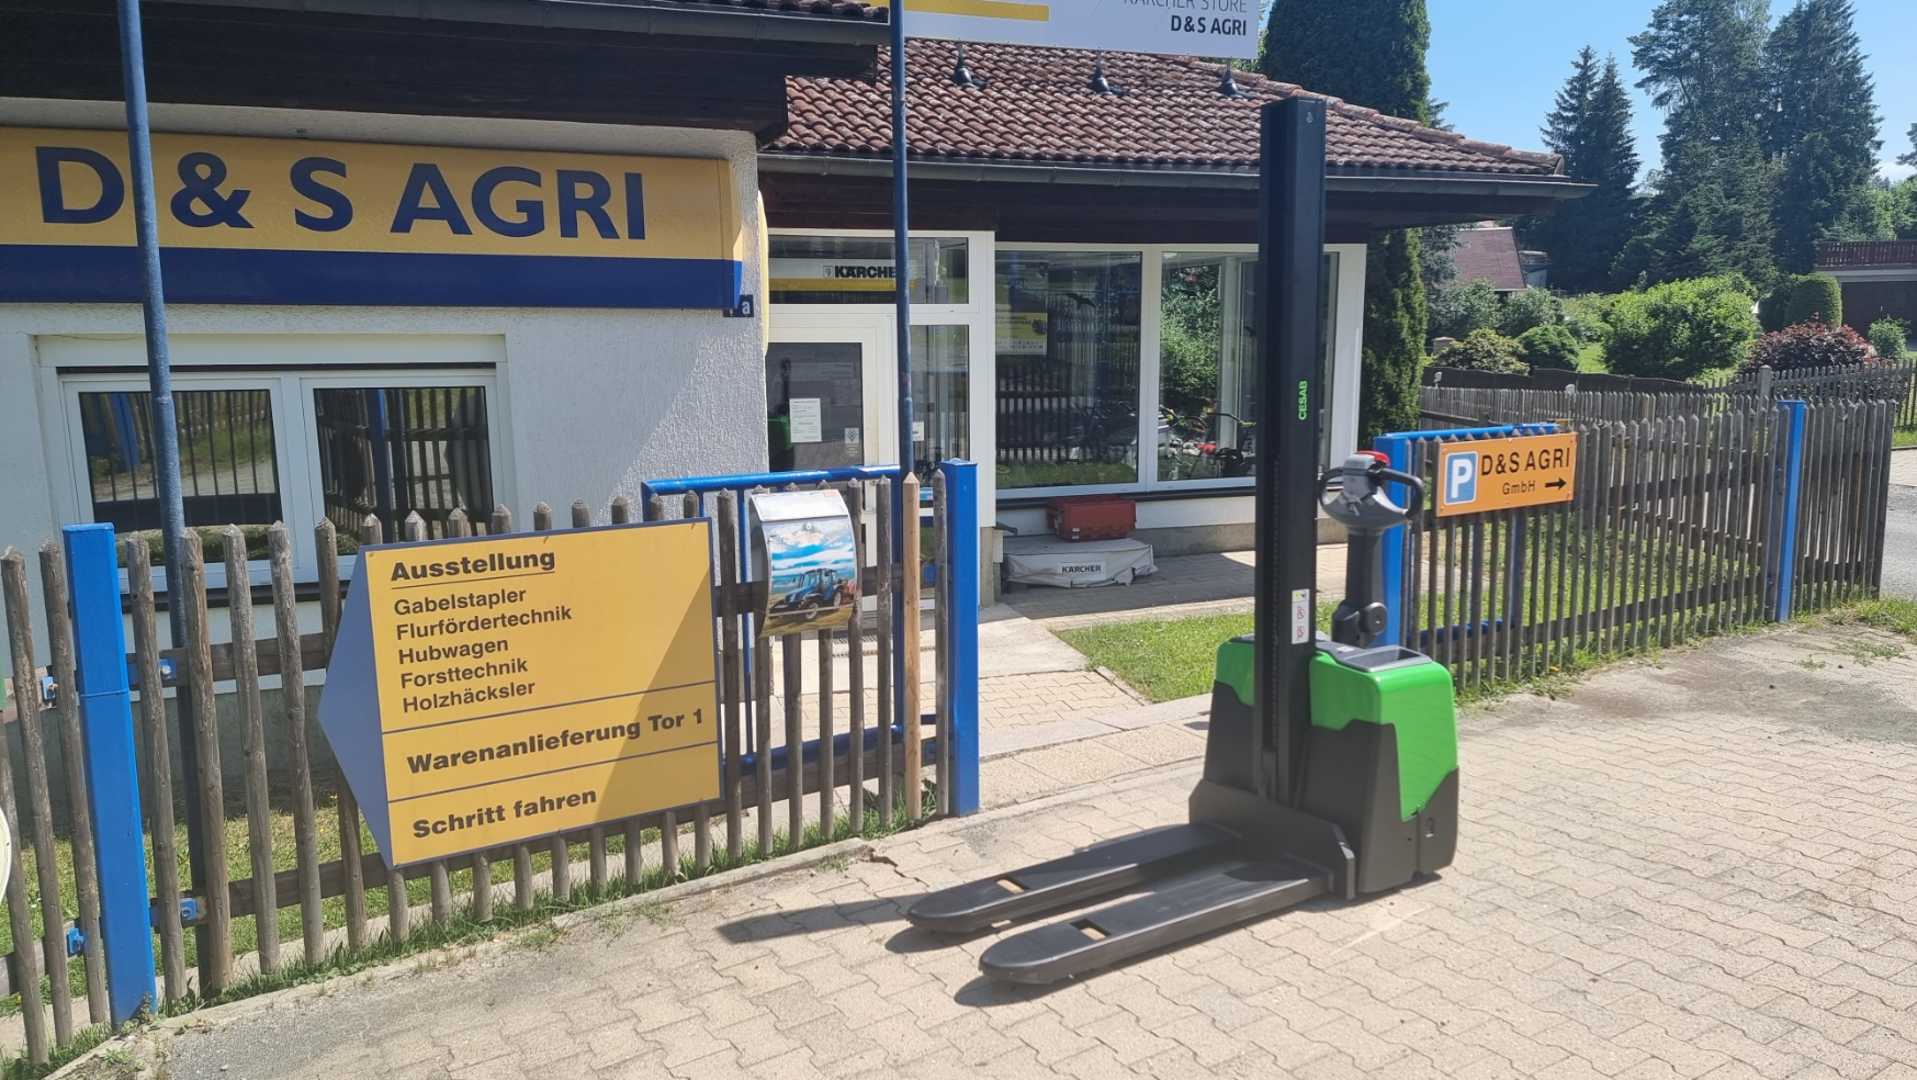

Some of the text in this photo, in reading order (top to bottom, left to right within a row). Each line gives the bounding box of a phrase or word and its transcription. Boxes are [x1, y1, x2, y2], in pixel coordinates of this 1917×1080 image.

[1210, 17, 1247, 36] AGRI
[35, 145, 646, 241] D & S AGRI
[834, 265, 897, 279] KÄRCHE
[1298, 380, 1308, 420] CESAB
[1524, 447, 1570, 471] AGRI
[1502, 480, 1536, 495] GmbH
[391, 551, 556, 581] Ausstellung
[394, 588, 527, 616] Gabelstapler
[396, 606, 572, 641] Flurfördertechnik
[398, 638, 509, 665] Hubwagen
[400, 657, 528, 689] Forsttechnik
[402, 681, 536, 713] Holzhäcksler
[407, 708, 703, 774] Warenanlieferung Tor 1
[413, 789, 597, 839] Schritt fahren
